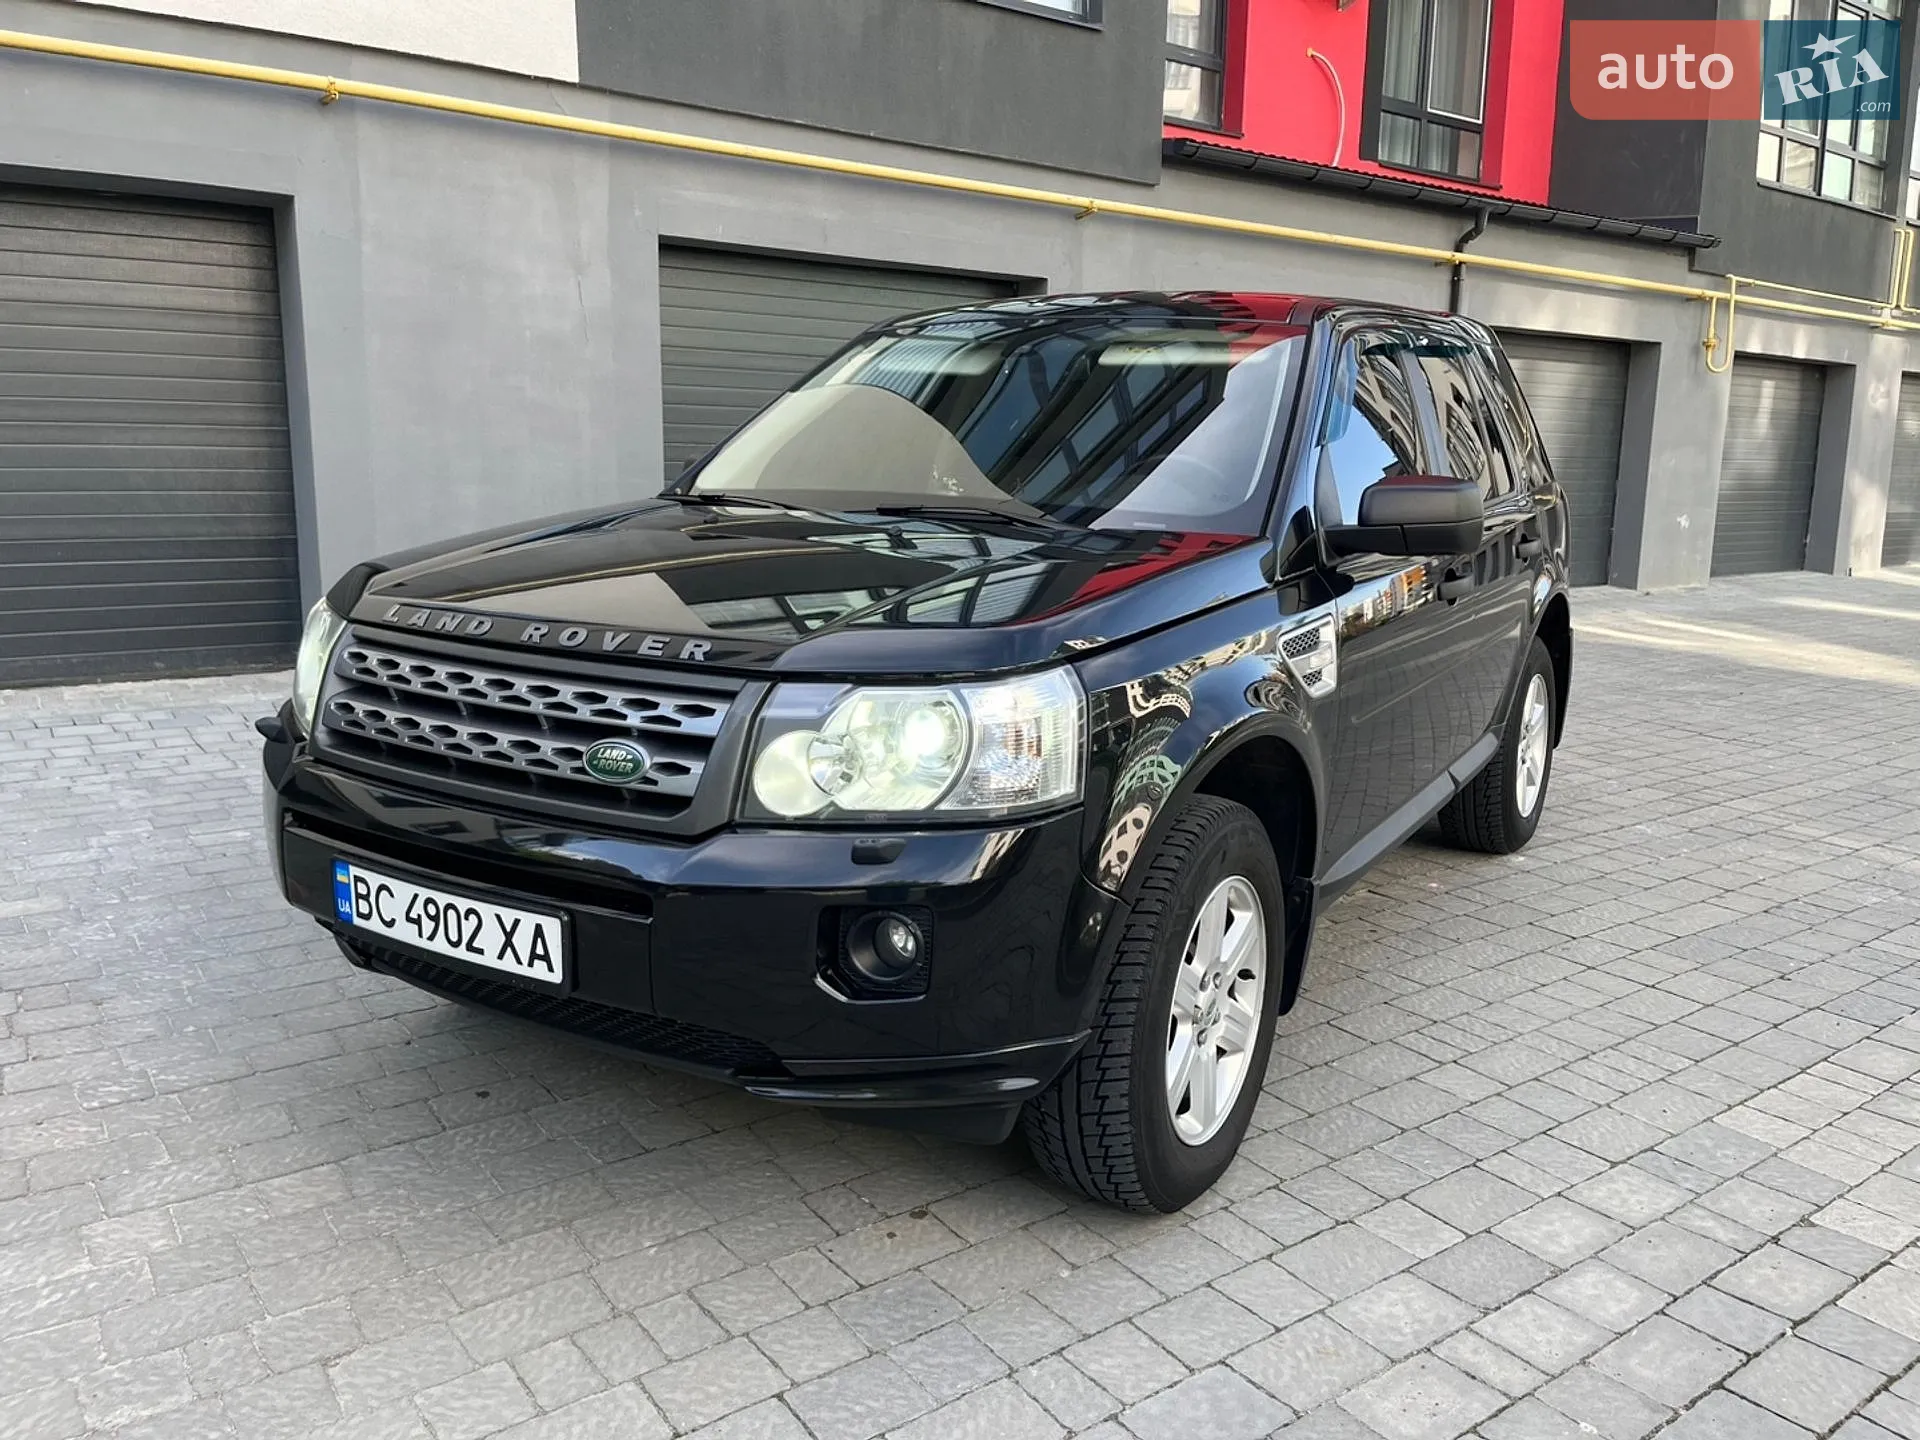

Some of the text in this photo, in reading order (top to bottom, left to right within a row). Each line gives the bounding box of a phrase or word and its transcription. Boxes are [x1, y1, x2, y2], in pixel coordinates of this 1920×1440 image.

[382, 604, 713, 662] LAND ROVER
[597, 747, 627, 761] LAND
[598, 758, 634, 773] ROVER
[338, 897, 352, 914] UA
[353, 874, 555, 973] BC 4902 XA
